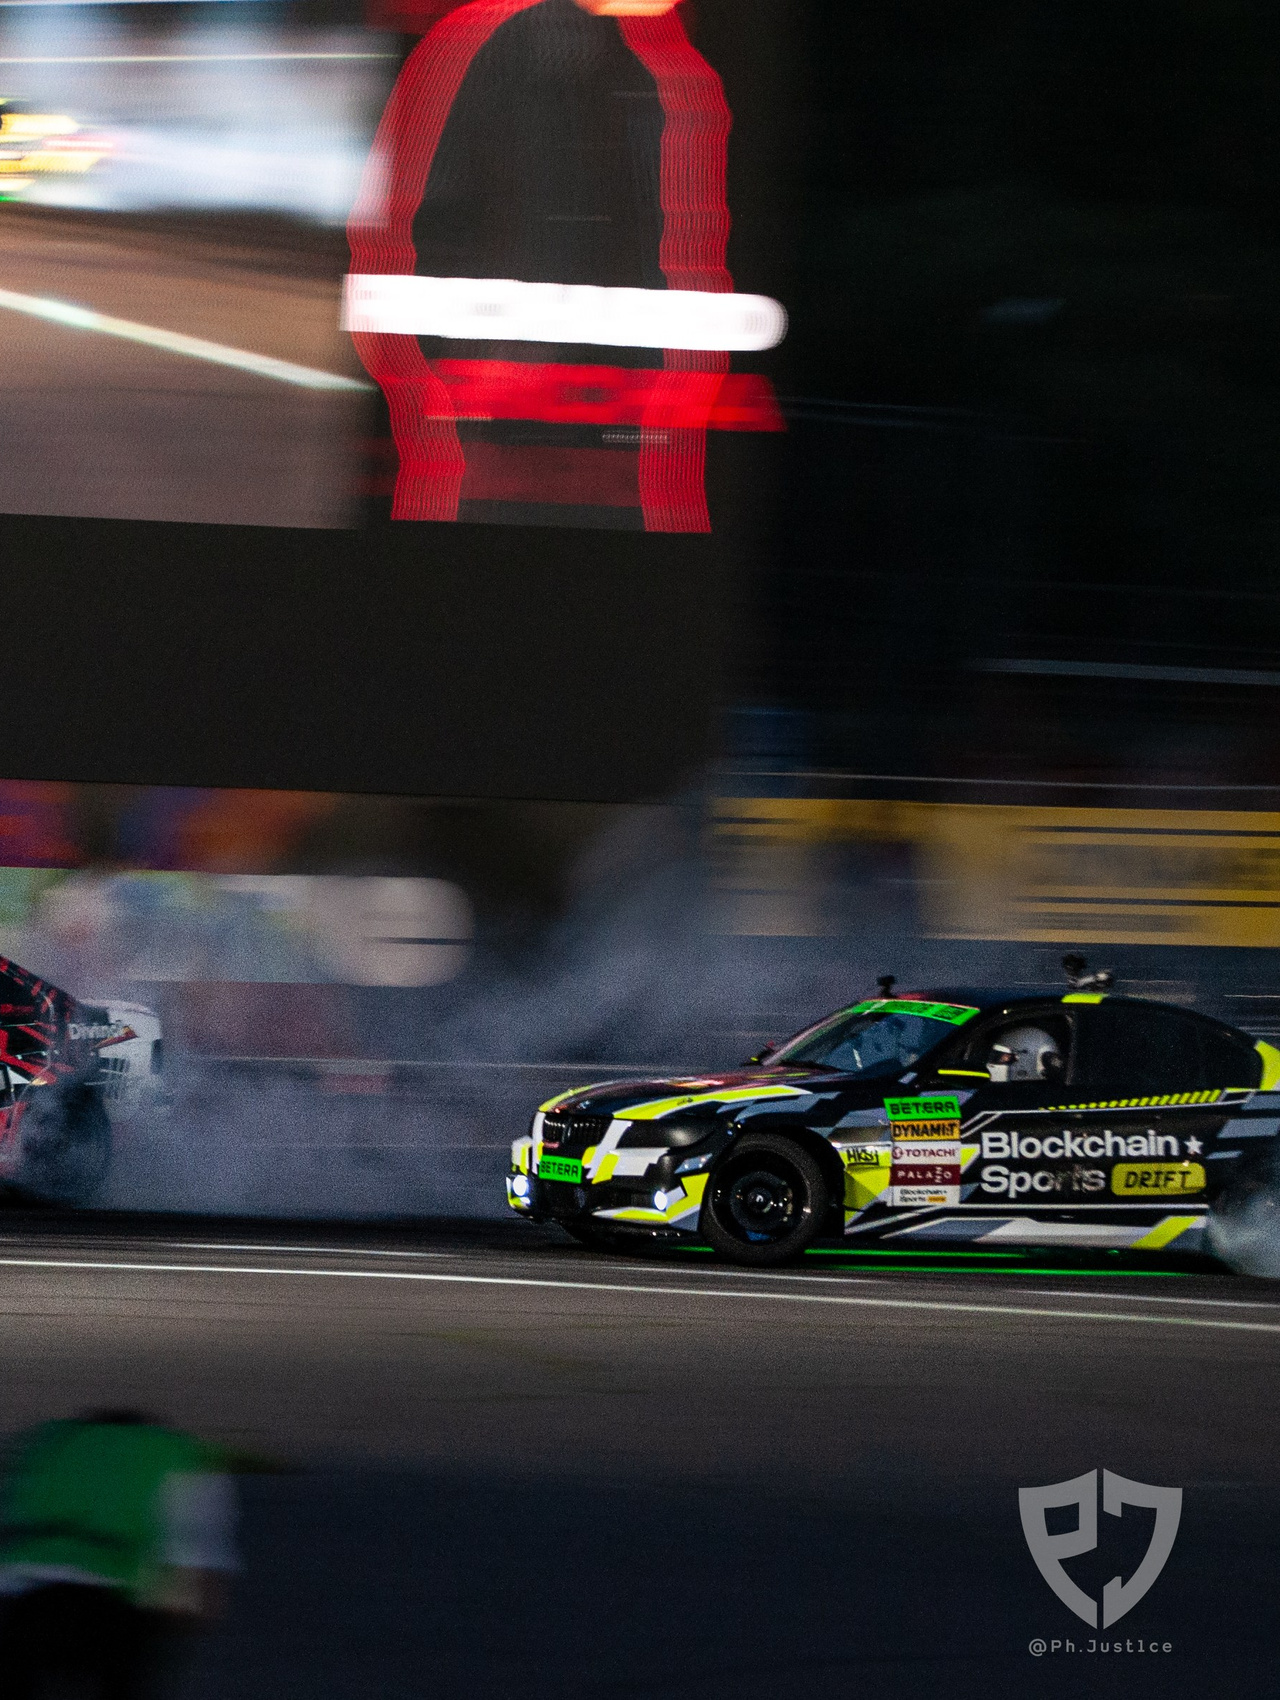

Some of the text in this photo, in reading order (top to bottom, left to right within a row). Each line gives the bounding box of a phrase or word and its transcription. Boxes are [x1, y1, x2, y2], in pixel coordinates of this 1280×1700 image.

[905, 1148, 956, 1158] TOTACHI
[981, 1129, 1181, 1160] Blockchain
[1124, 1170, 1192, 1189] DRIFT
